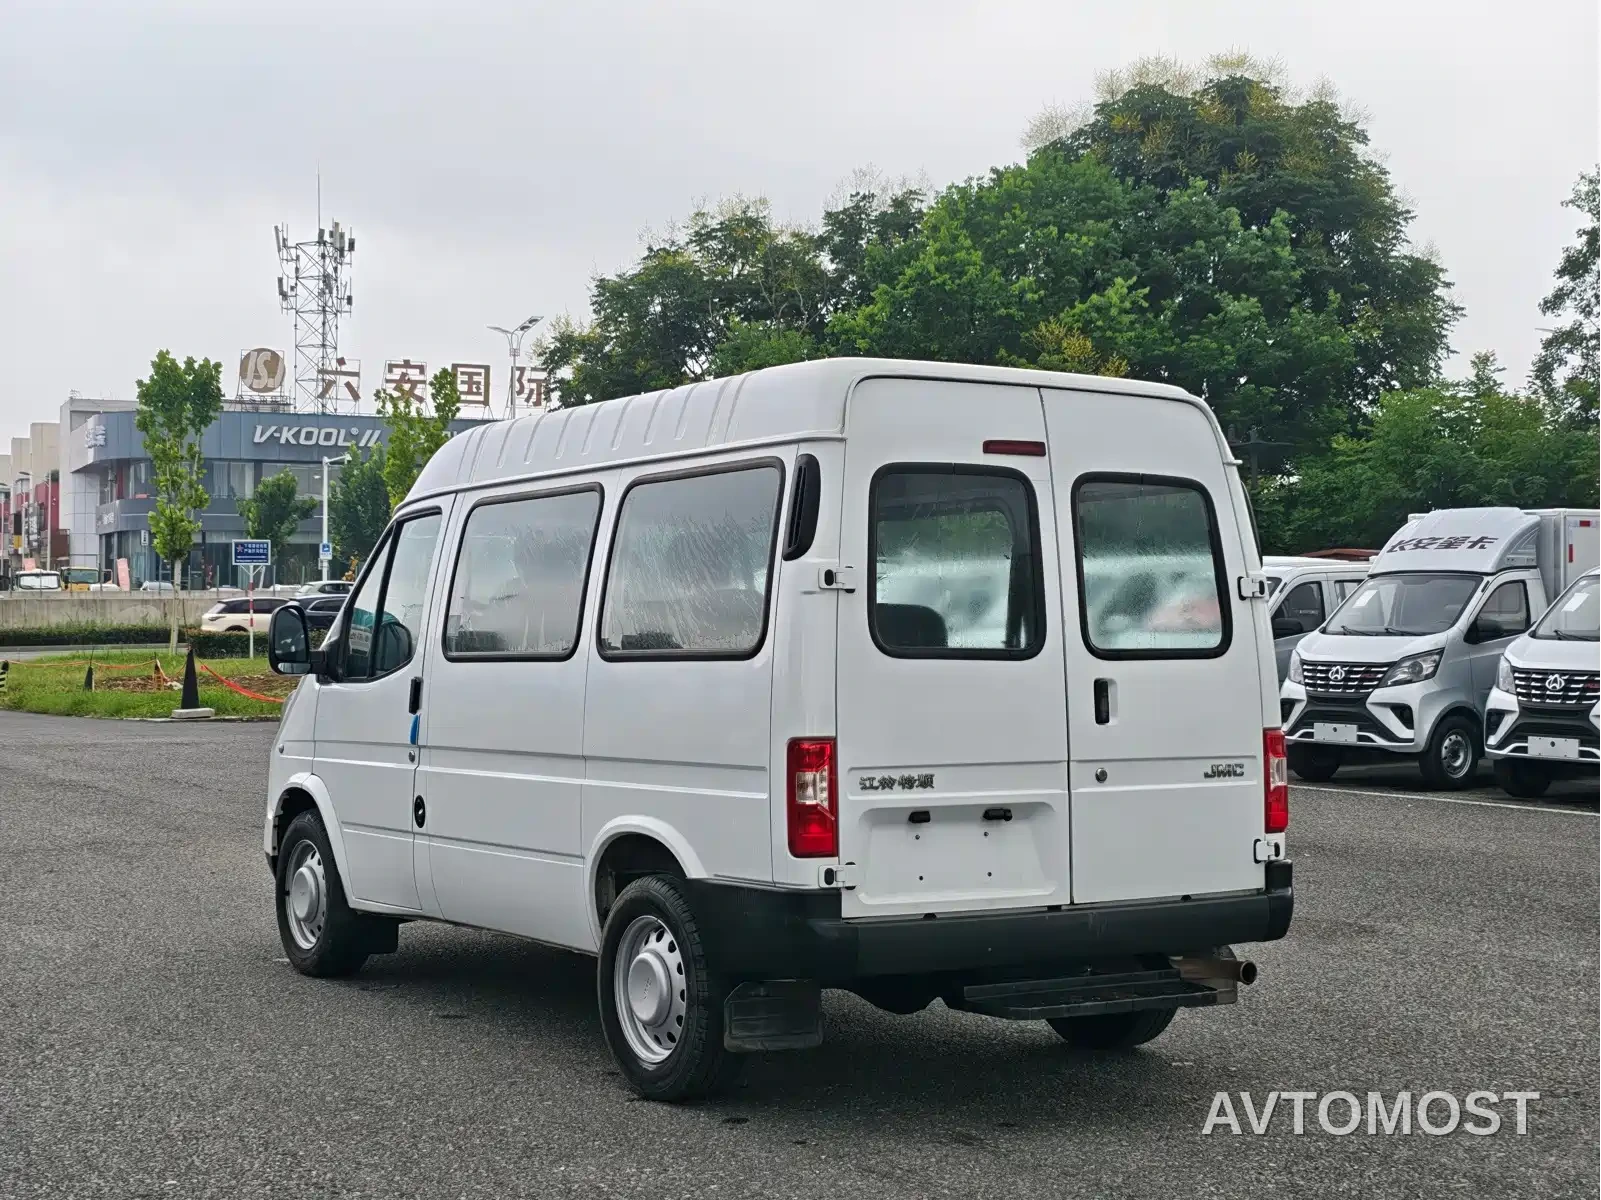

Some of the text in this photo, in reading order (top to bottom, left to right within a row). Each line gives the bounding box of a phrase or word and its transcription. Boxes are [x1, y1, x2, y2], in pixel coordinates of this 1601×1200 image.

[1386, 535, 1499, 553] 长安星卡
[1203, 763, 1245, 779] JMC
